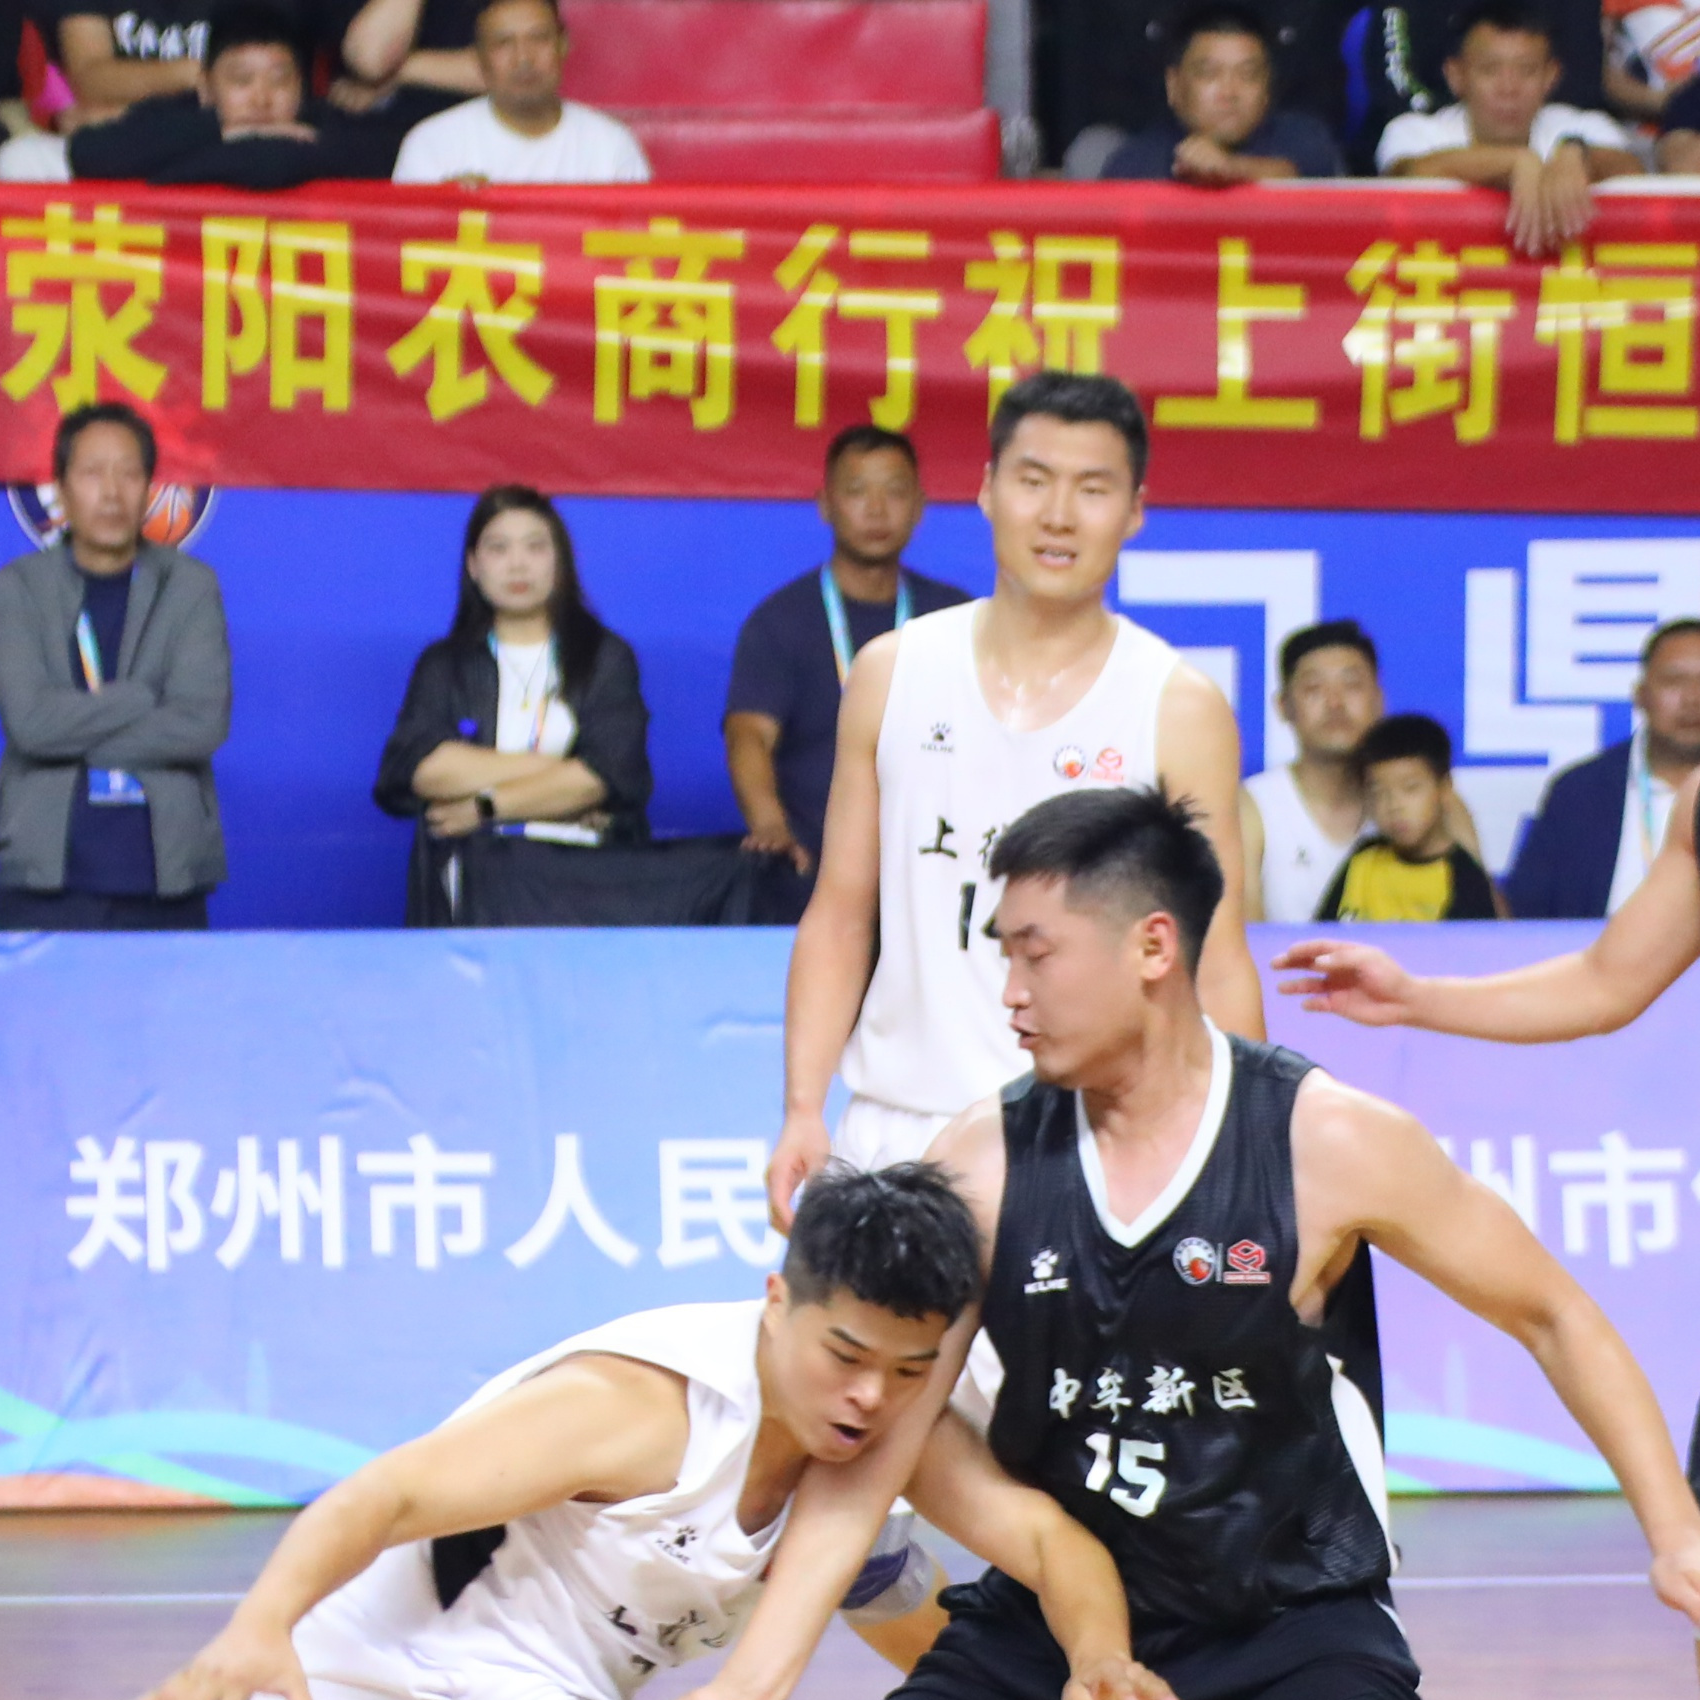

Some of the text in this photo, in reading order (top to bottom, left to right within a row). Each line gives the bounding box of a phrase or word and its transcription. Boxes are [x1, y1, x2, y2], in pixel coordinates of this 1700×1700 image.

[64, 1134, 787, 1273] 郑州市人民
[1048, 1364, 1258, 1424] 中牟新区
[1085, 1431, 1167, 1519] 15
